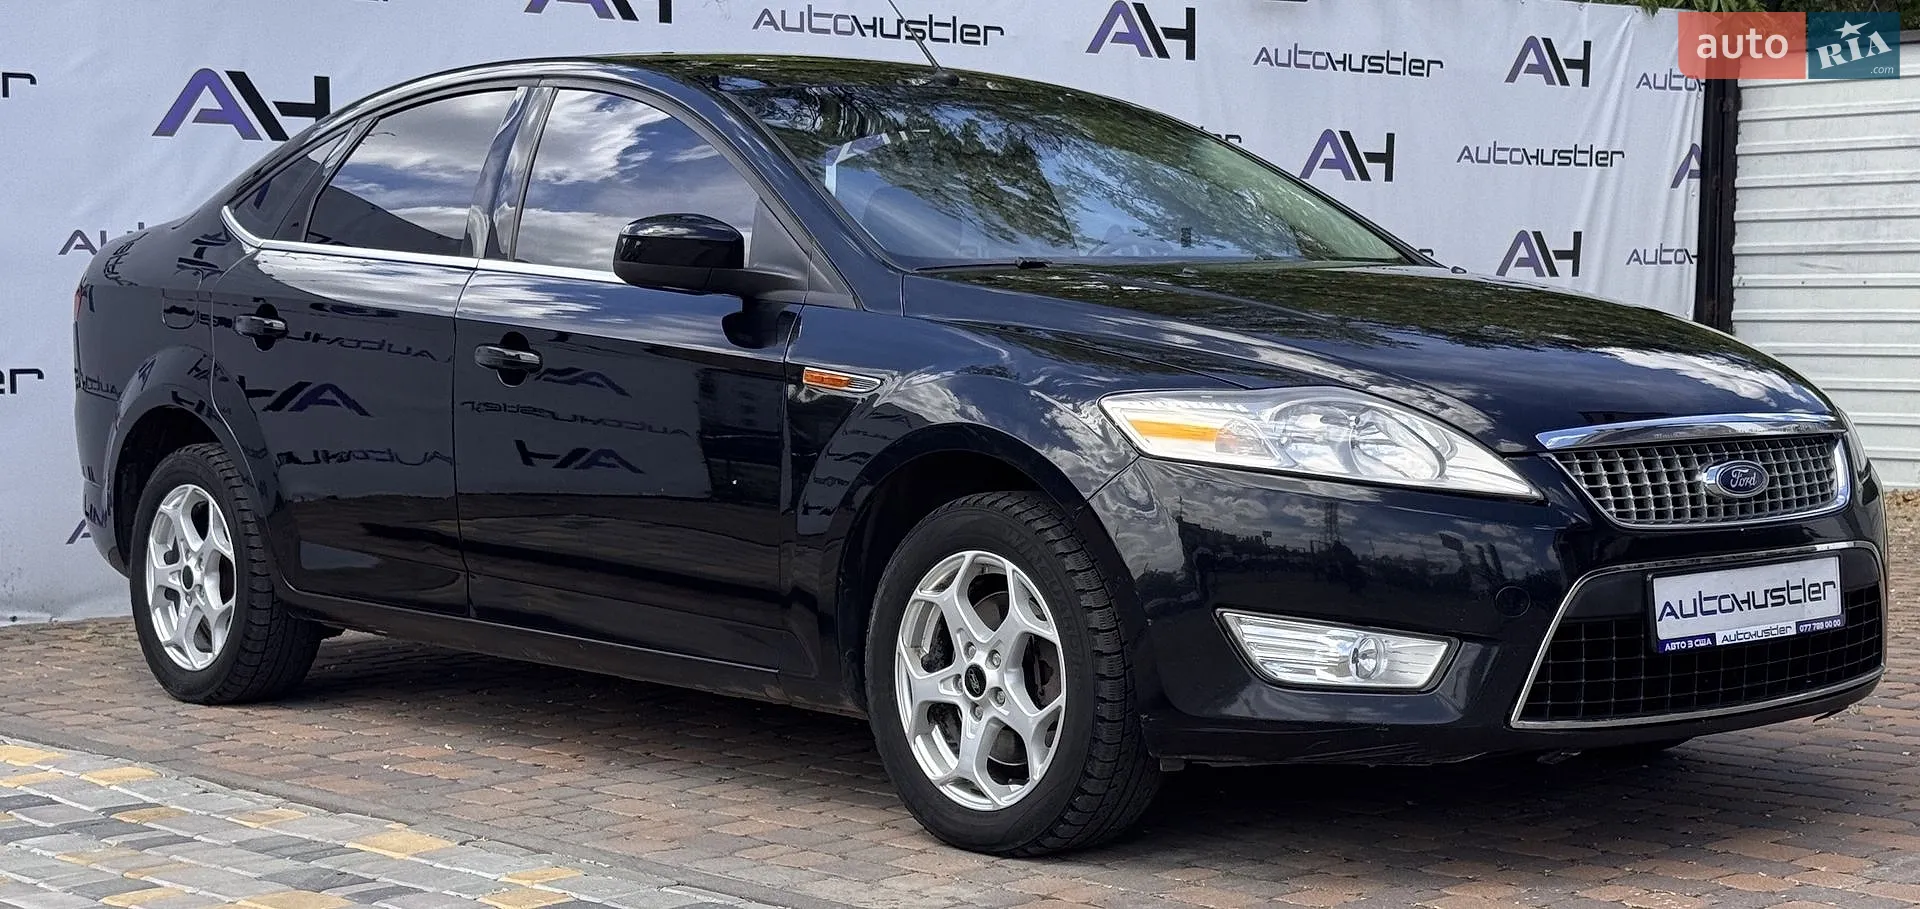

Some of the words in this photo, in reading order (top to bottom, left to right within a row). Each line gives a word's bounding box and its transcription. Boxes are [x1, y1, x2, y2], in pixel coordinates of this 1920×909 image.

[1086, 0, 1196, 60] AH
[1505, 36, 1591, 87] AH
[1300, 128, 1395, 182] AH
[1496, 229, 1582, 277] AH
[1730, 469, 1757, 488] Ford
[1695, 636, 1712, 648] США
